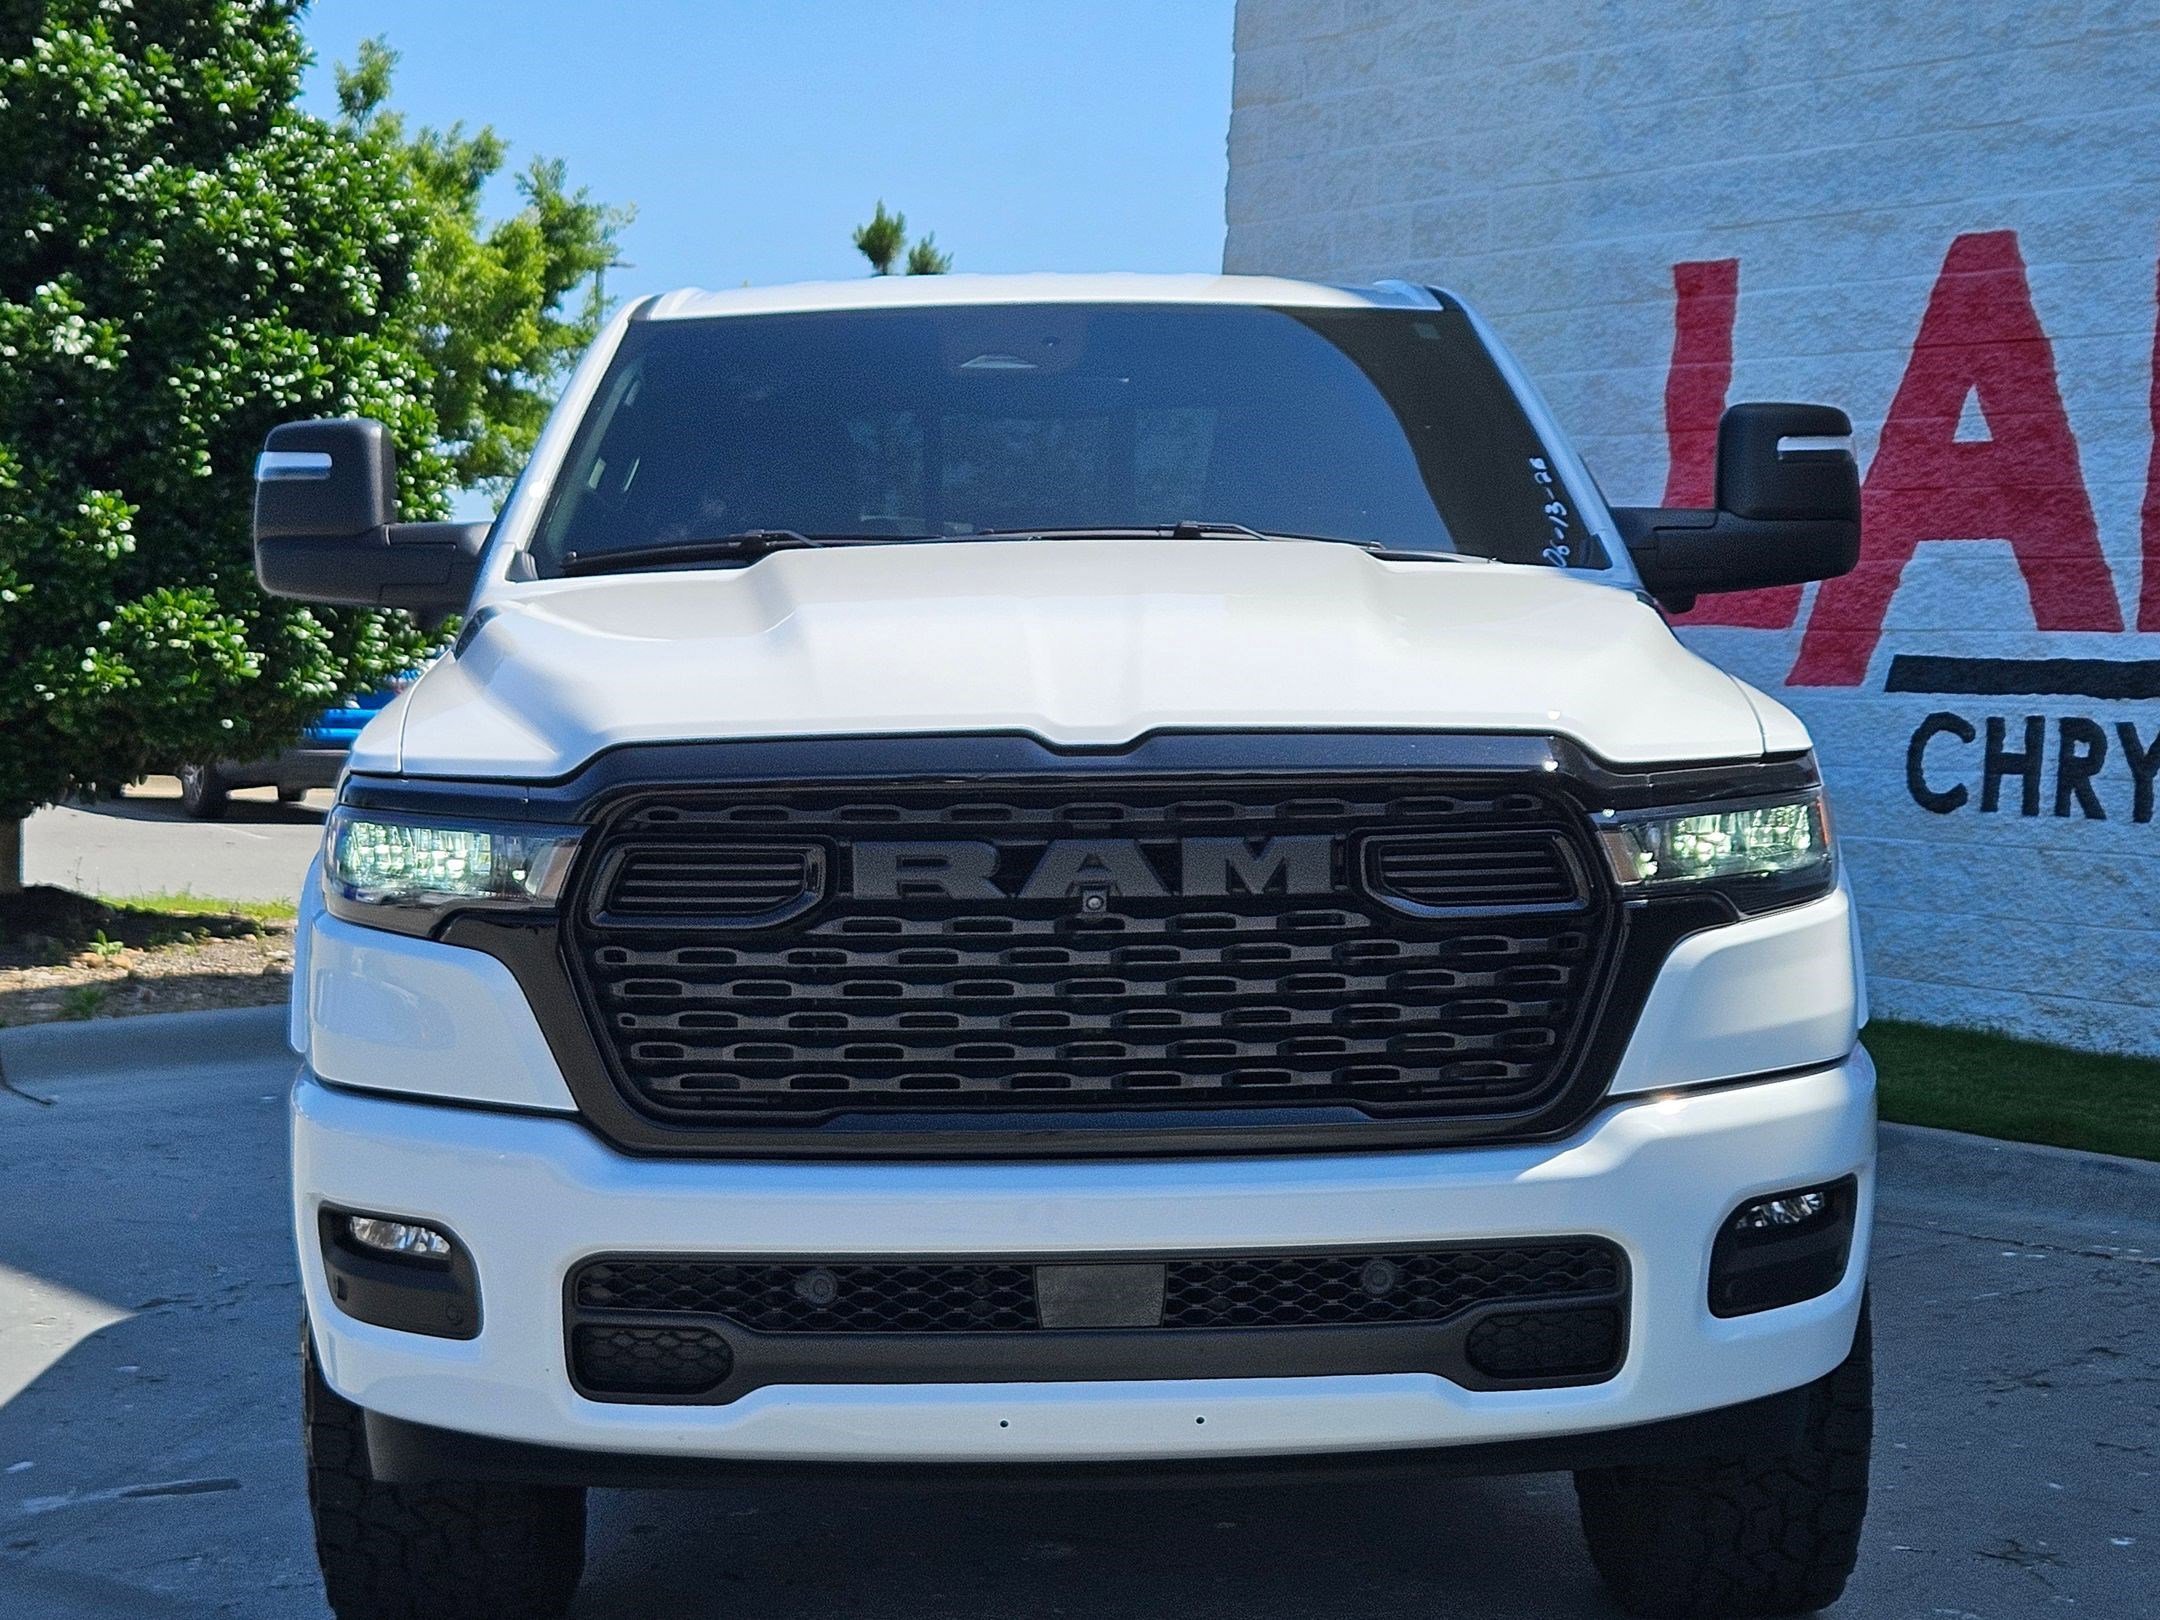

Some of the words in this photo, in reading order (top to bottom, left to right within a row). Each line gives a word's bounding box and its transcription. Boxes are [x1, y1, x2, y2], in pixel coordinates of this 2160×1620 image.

[1661, 230, 2160, 687] LA
[1906, 711, 2160, 823] CHRY
[852, 834, 1334, 899] RAM
